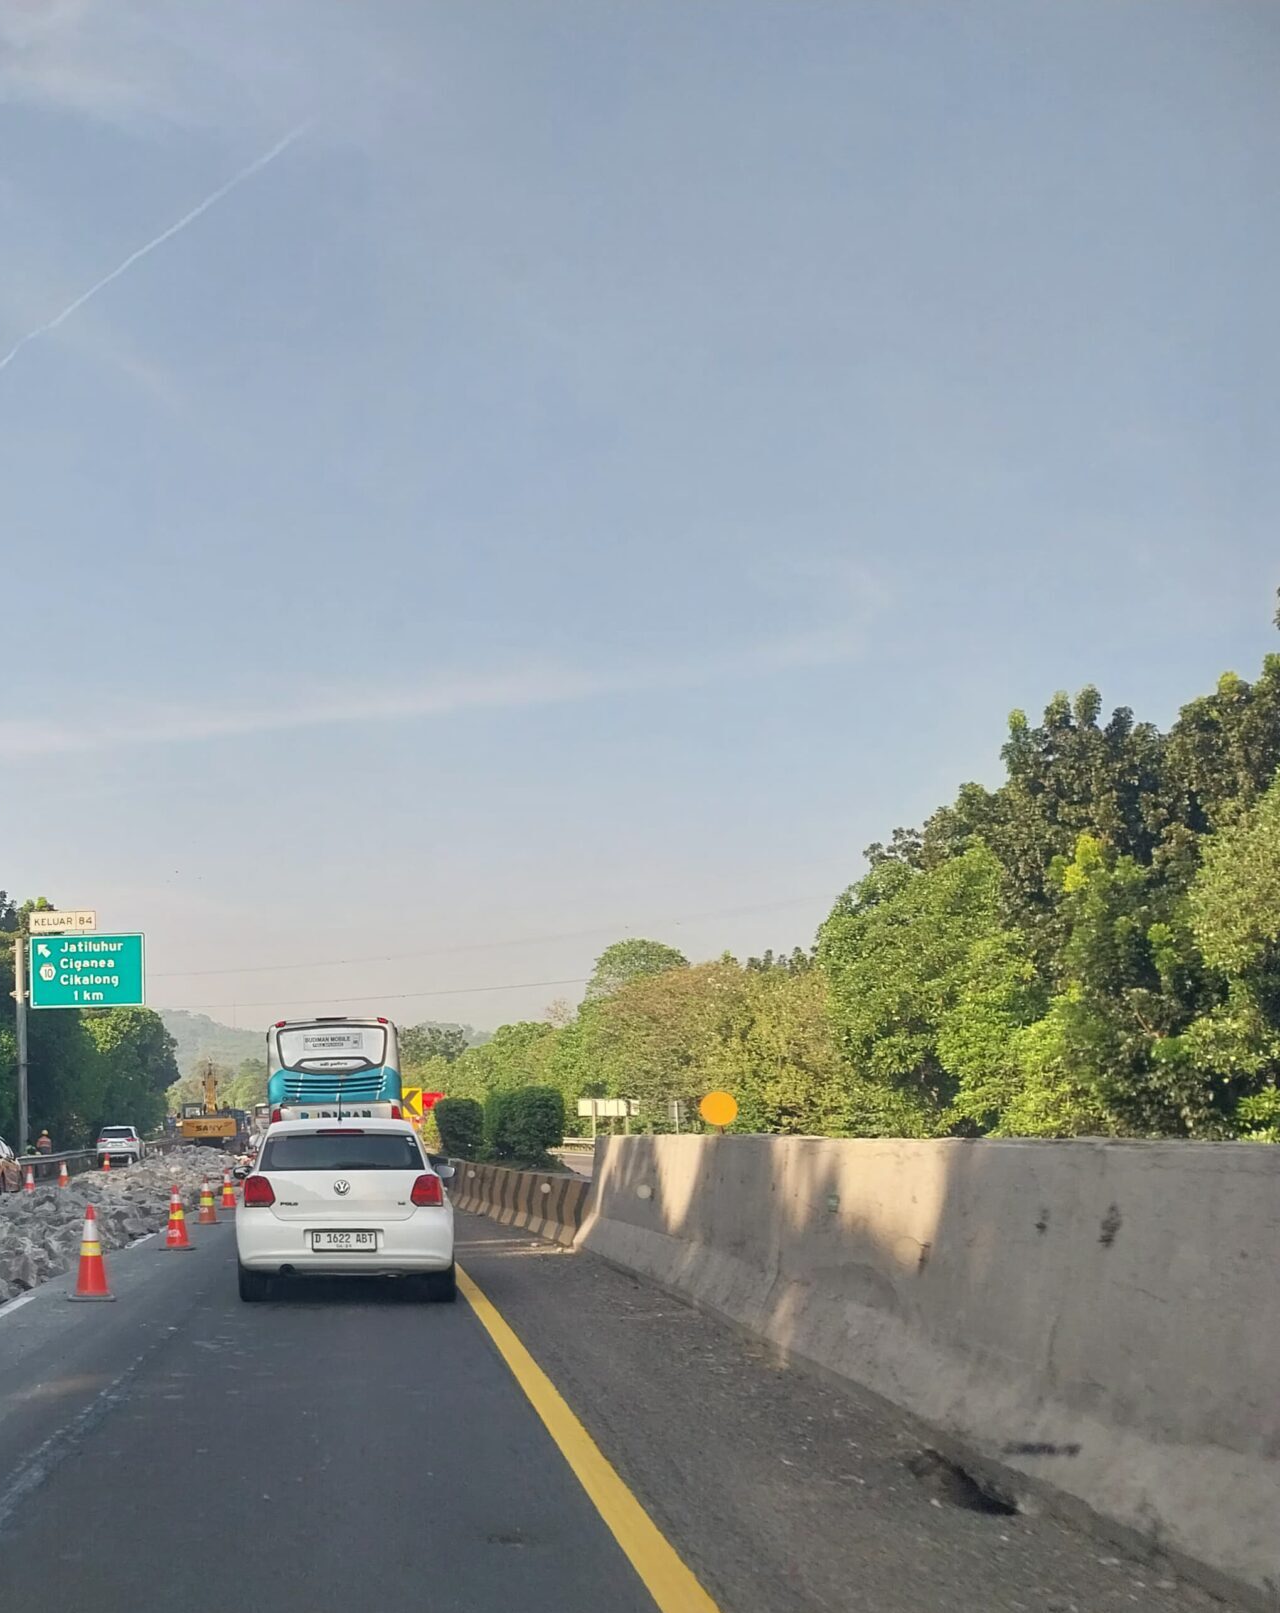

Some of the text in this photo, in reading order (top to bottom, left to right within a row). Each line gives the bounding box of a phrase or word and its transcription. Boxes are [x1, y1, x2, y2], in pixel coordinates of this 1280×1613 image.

[34, 917, 93, 926] KELUAR 84
[60, 941, 123, 953] Jatiluhur
[60, 958, 115, 971] Ciganea
[60, 974, 119, 987] Cikalong
[73, 990, 104, 1000] 1 km
[315, 1233, 374, 1243] D 1622 ABT
